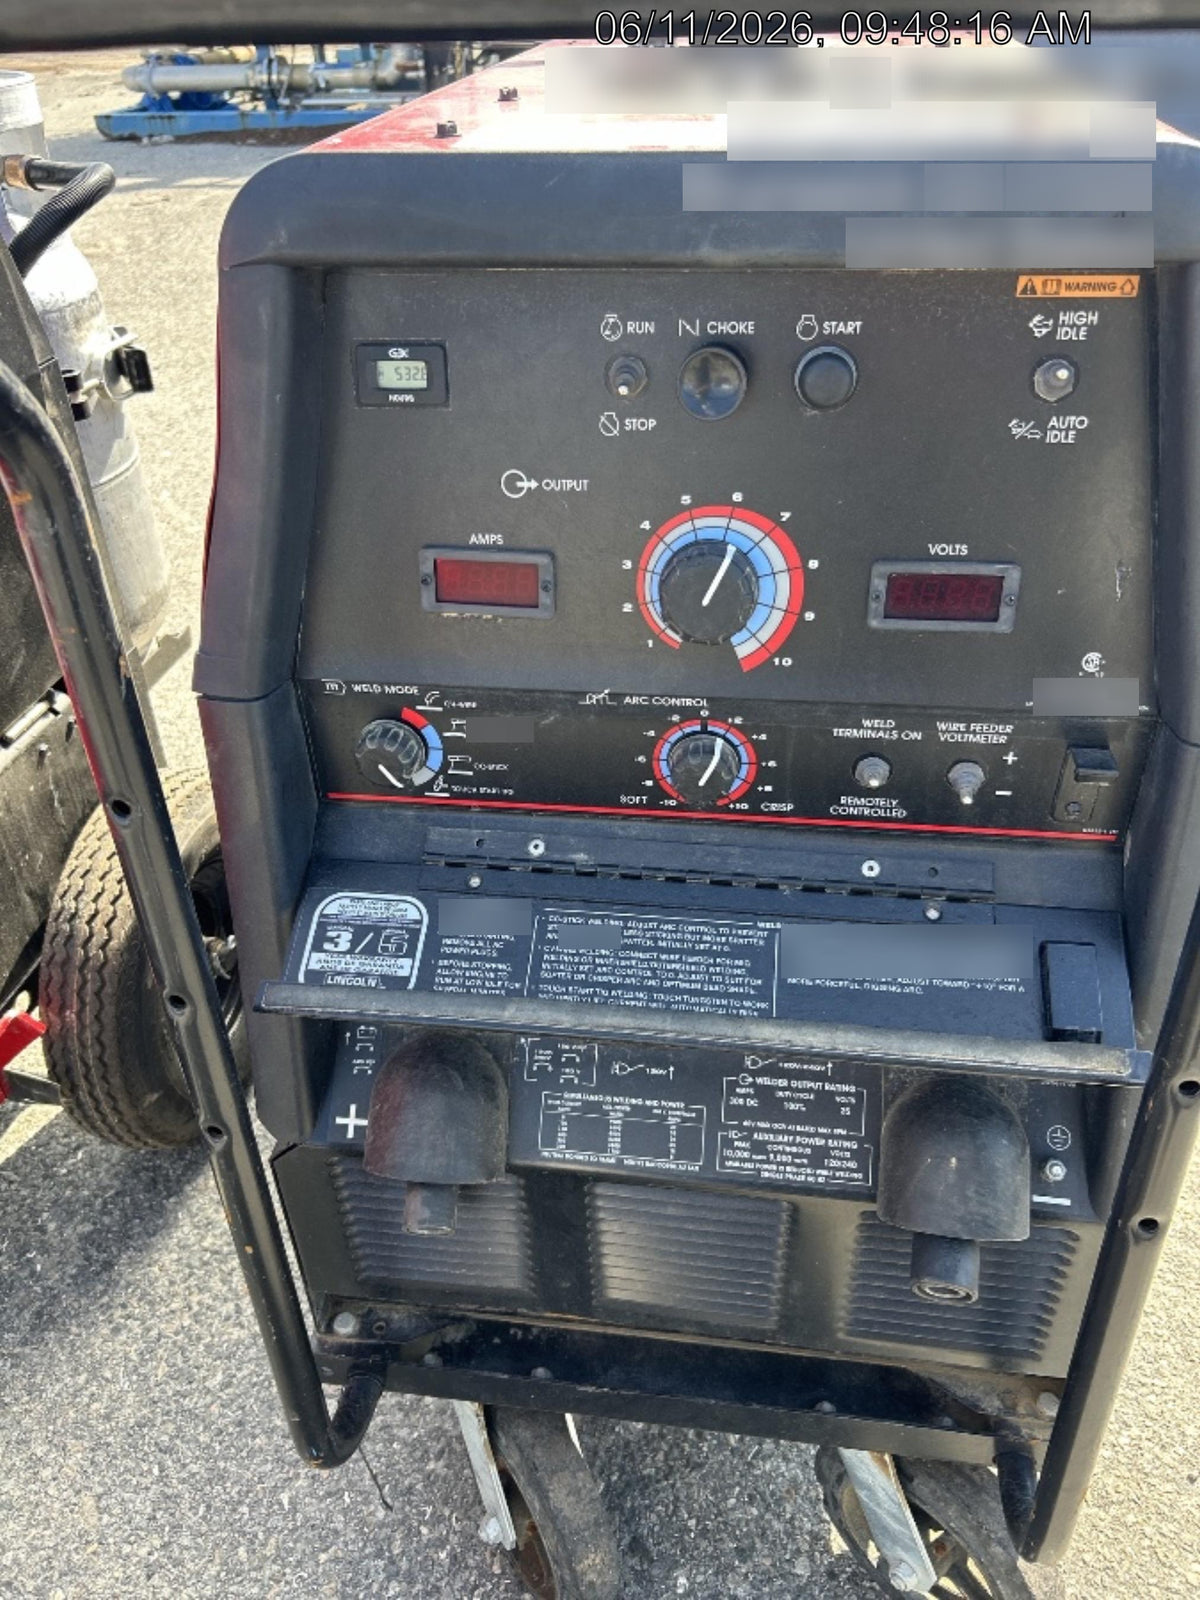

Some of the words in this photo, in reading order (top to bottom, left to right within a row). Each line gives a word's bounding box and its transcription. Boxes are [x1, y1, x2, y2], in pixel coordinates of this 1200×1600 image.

[1064, 282, 1116, 292] WARNING
[1058, 311, 1098, 326] HIGH
[627, 322, 655, 334] RUN
[707, 322, 755, 336] CHOKE
[823, 322, 862, 335] START
[1056, 327, 1088, 340] IDLE
[624, 418, 656, 432] STOP
[1047, 416, 1088, 430] AUTO
[1046, 430, 1076, 444] IDLE
[542, 479, 590, 492] OUTPUT
[680, 495, 691, 505] 5
[732, 492, 743, 503] 6
[780, 512, 791, 522] 7
[640, 521, 651, 530] 4
[469, 534, 504, 544] AMPS
[928, 544, 968, 556] VOLTS
[622, 560, 632, 570] 3
[808, 559, 818, 569] 8
[622, 602, 633, 612] 2
[804, 611, 815, 621] 9
[647, 639, 653, 648] 1
[773, 657, 792, 667] 10
[352, 684, 382, 693] WELD
[384, 685, 419, 695] MODE
[624, 696, 650, 705] ARC
[652, 697, 708, 708] CONTROL
[862, 718, 895, 728] WELD
[936, 721, 966, 733] WIRE
[969, 722, 1014, 734] FEEDER
[832, 728, 898, 741] TERMINALS
[901, 730, 922, 741] ON
[938, 732, 1008, 744] VOLTMETER
[620, 795, 648, 805] SOFT
[840, 796, 898, 808] REMOTELY
[728, 802, 749, 811] +10
[760, 802, 794, 812] CRISP
[829, 806, 907, 818] CONTROLLED
[327, 975, 377, 987] LINCOLN
[790, 1080, 822, 1091] OUTPUT
